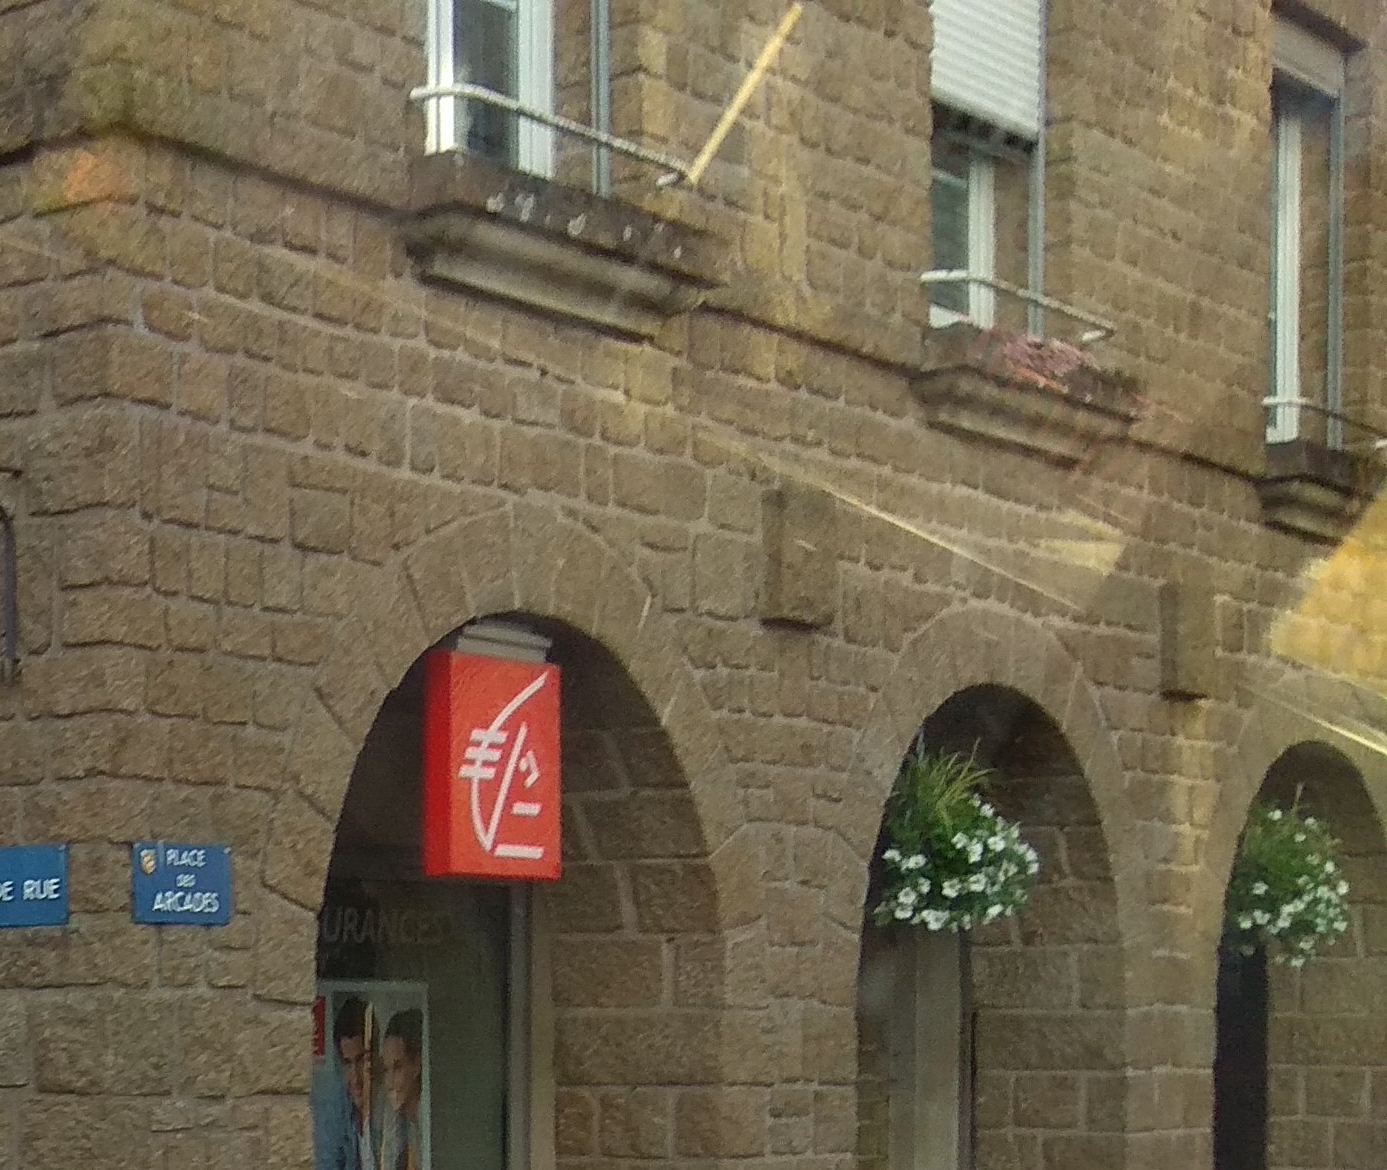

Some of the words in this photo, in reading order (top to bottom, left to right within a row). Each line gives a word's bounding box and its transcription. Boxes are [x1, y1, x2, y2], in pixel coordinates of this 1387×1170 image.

[166, 849, 206, 867] PLACE
[22, 878, 61, 901] RUE
[152, 890, 221, 914] ARCADES
